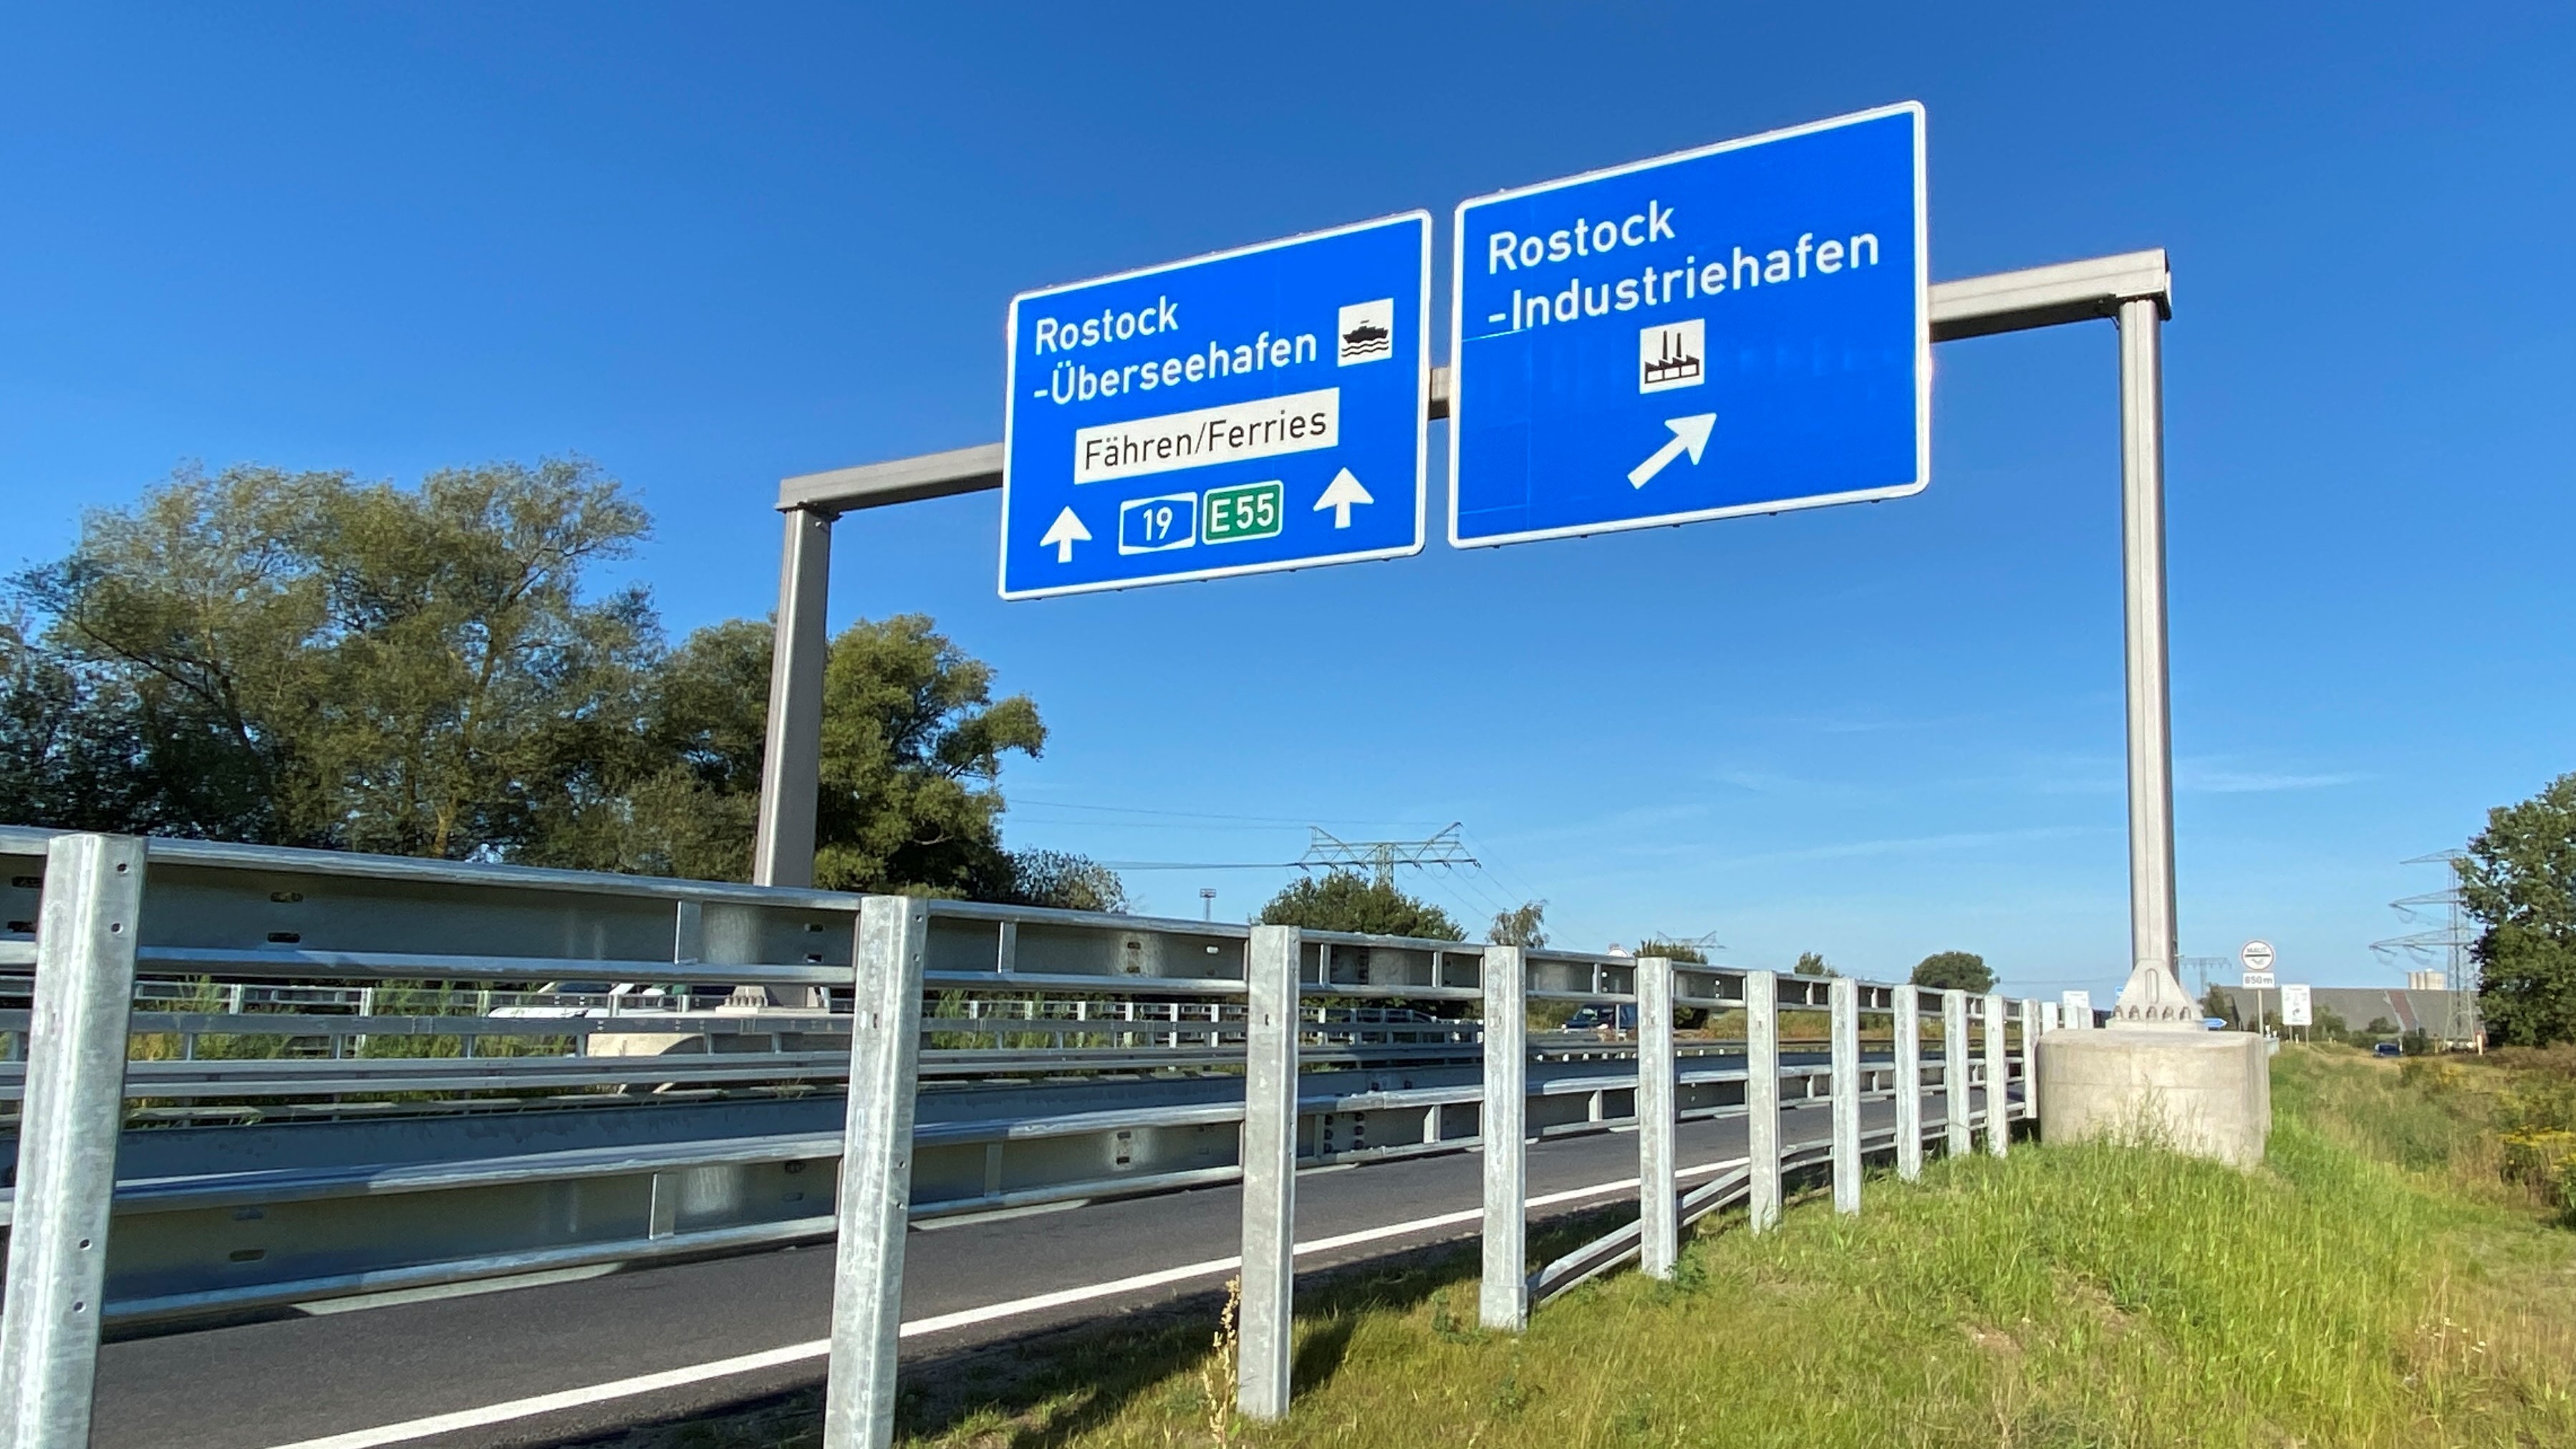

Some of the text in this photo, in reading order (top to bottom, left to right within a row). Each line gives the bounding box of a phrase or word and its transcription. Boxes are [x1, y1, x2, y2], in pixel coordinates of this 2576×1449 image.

[1490, 200, 1675, 274] Rostock
[1489, 233, 1878, 329] -Industriehafen
[1036, 296, 1178, 355] Rostock
[1034, 332, 1316, 404] -Überseehafen
[1086, 410, 1326, 470] Fähren/Ferries
[1143, 506, 1173, 541] 19
